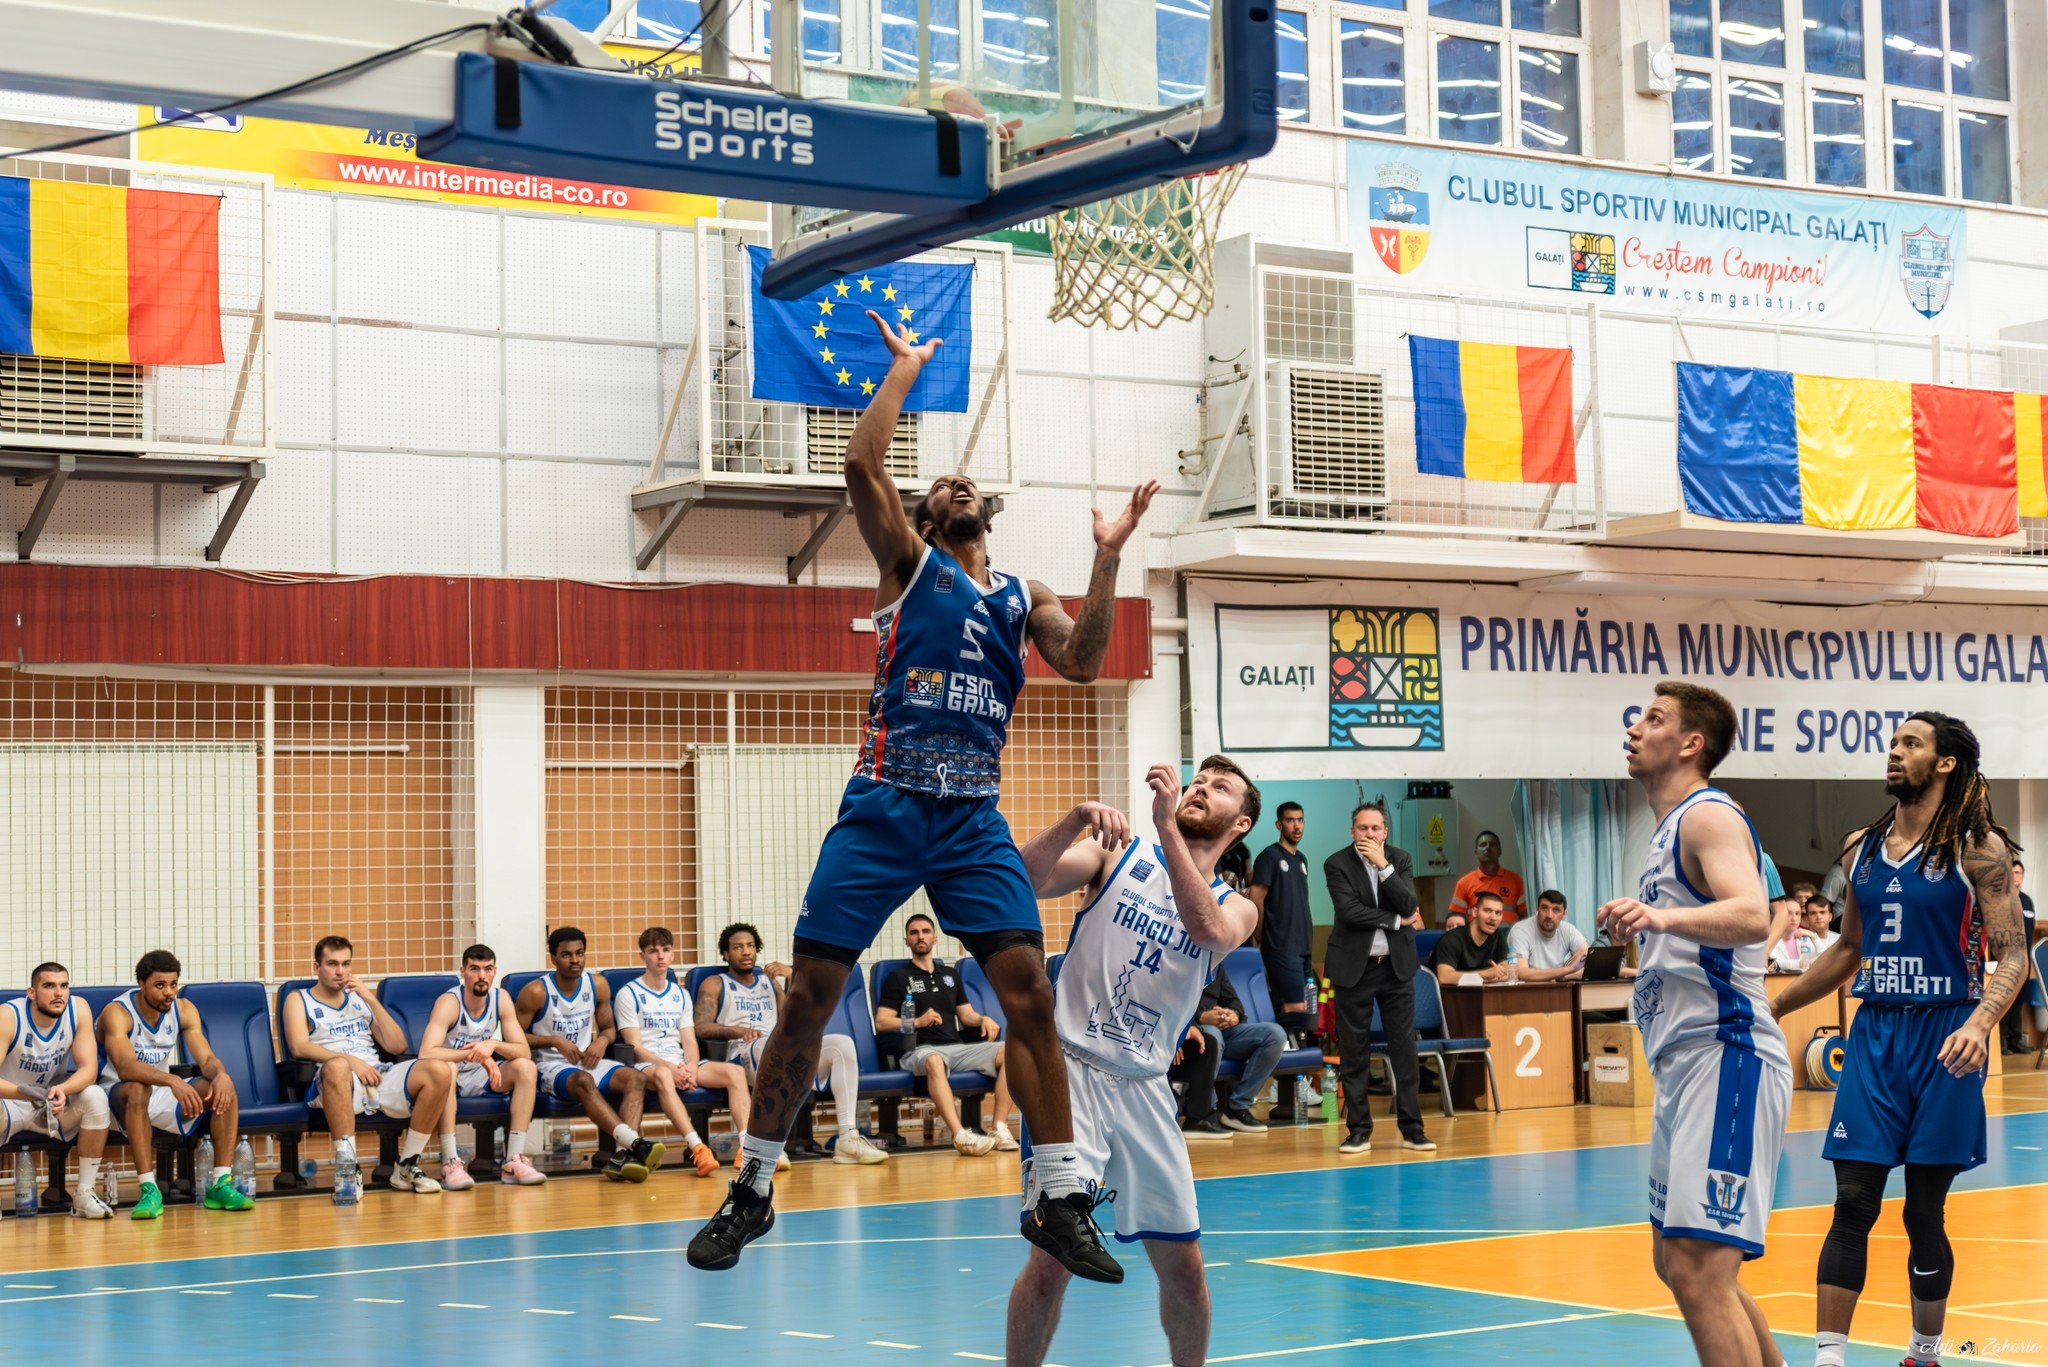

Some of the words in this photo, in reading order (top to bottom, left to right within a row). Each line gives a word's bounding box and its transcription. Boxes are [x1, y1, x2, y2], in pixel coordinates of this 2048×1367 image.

[654, 91, 814, 138] Schelde
[655, 121, 815, 166] Sports
[338, 161, 629, 207] www.intermedia-co.ro
[1448, 175, 1554, 211] CLUBUL
[1560, 187, 1667, 222] SPORTIV
[1674, 200, 1800, 237] MUNICIPAL
[1806, 214, 1888, 252] GALAȚI
[1535, 251, 1565, 266] GALAȚI
[1622, 236, 1714, 282] Creștem
[1723, 246, 1829, 295] Campioni!
[959, 618, 989, 662] 5
[1459, 607, 1668, 676] PRIMĂRIA
[1677, 622, 1945, 682] MUNICIPIULUI
[950, 671, 995, 699] CSM
[1240, 665, 1315, 692] GALAȚI
[1795, 708, 1914, 754] SPORT
[1121, 888, 1147, 907] CLUBUL
[1886, 886, 1903, 894] PEAK
[1112, 901, 1174, 946] TÂRGU
[1880, 902, 1903, 943] 3
[1129, 940, 1163, 976] 14
[1873, 956, 1923, 976] CSM
[1873, 974, 1952, 995] GALATI
[1514, 1025, 1543, 1078] 2
